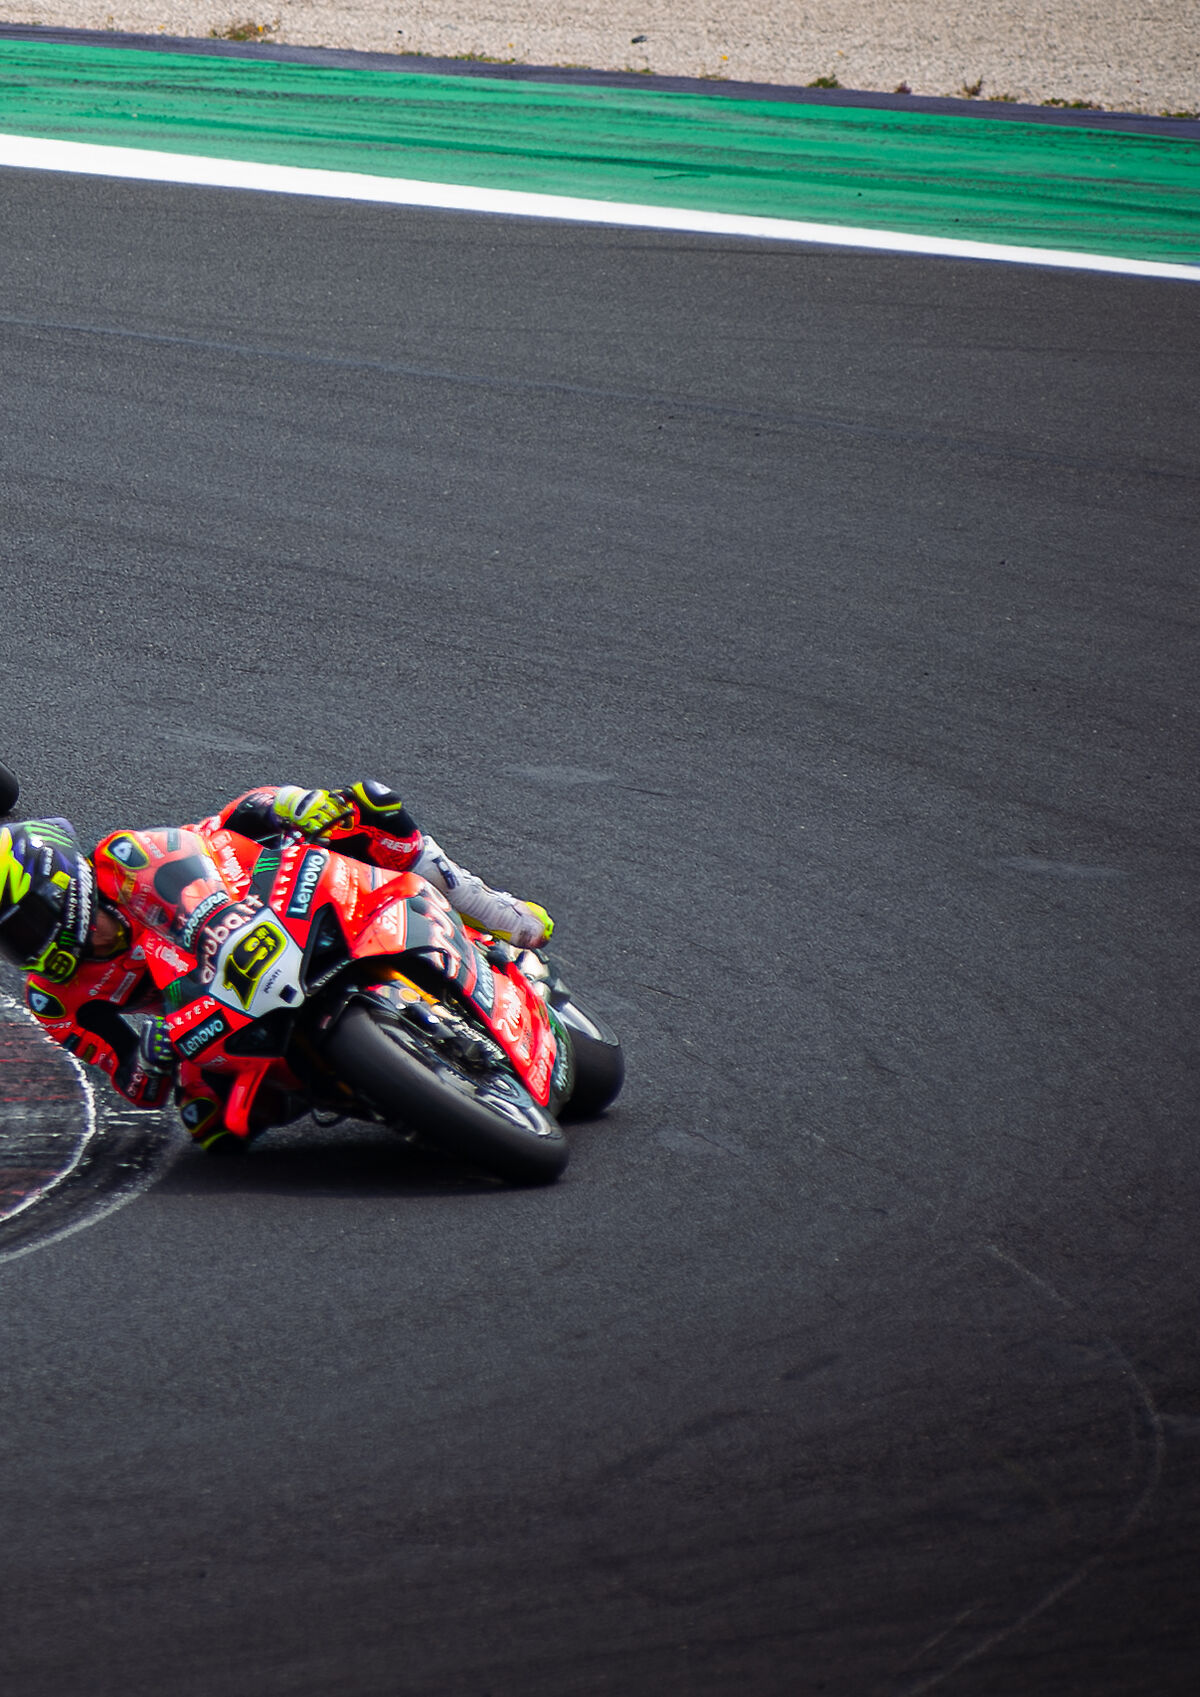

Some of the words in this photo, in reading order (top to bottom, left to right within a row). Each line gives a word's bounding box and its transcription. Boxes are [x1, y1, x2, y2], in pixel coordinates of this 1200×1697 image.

[274, 845, 301, 913] ALTEN
[293, 853, 327, 915] Lenovo
[182, 891, 231, 949] CARRERA
[200, 893, 266, 985] aruba.it
[223, 921, 287, 1010] 19
[179, 1018, 225, 1057] Lenovo
